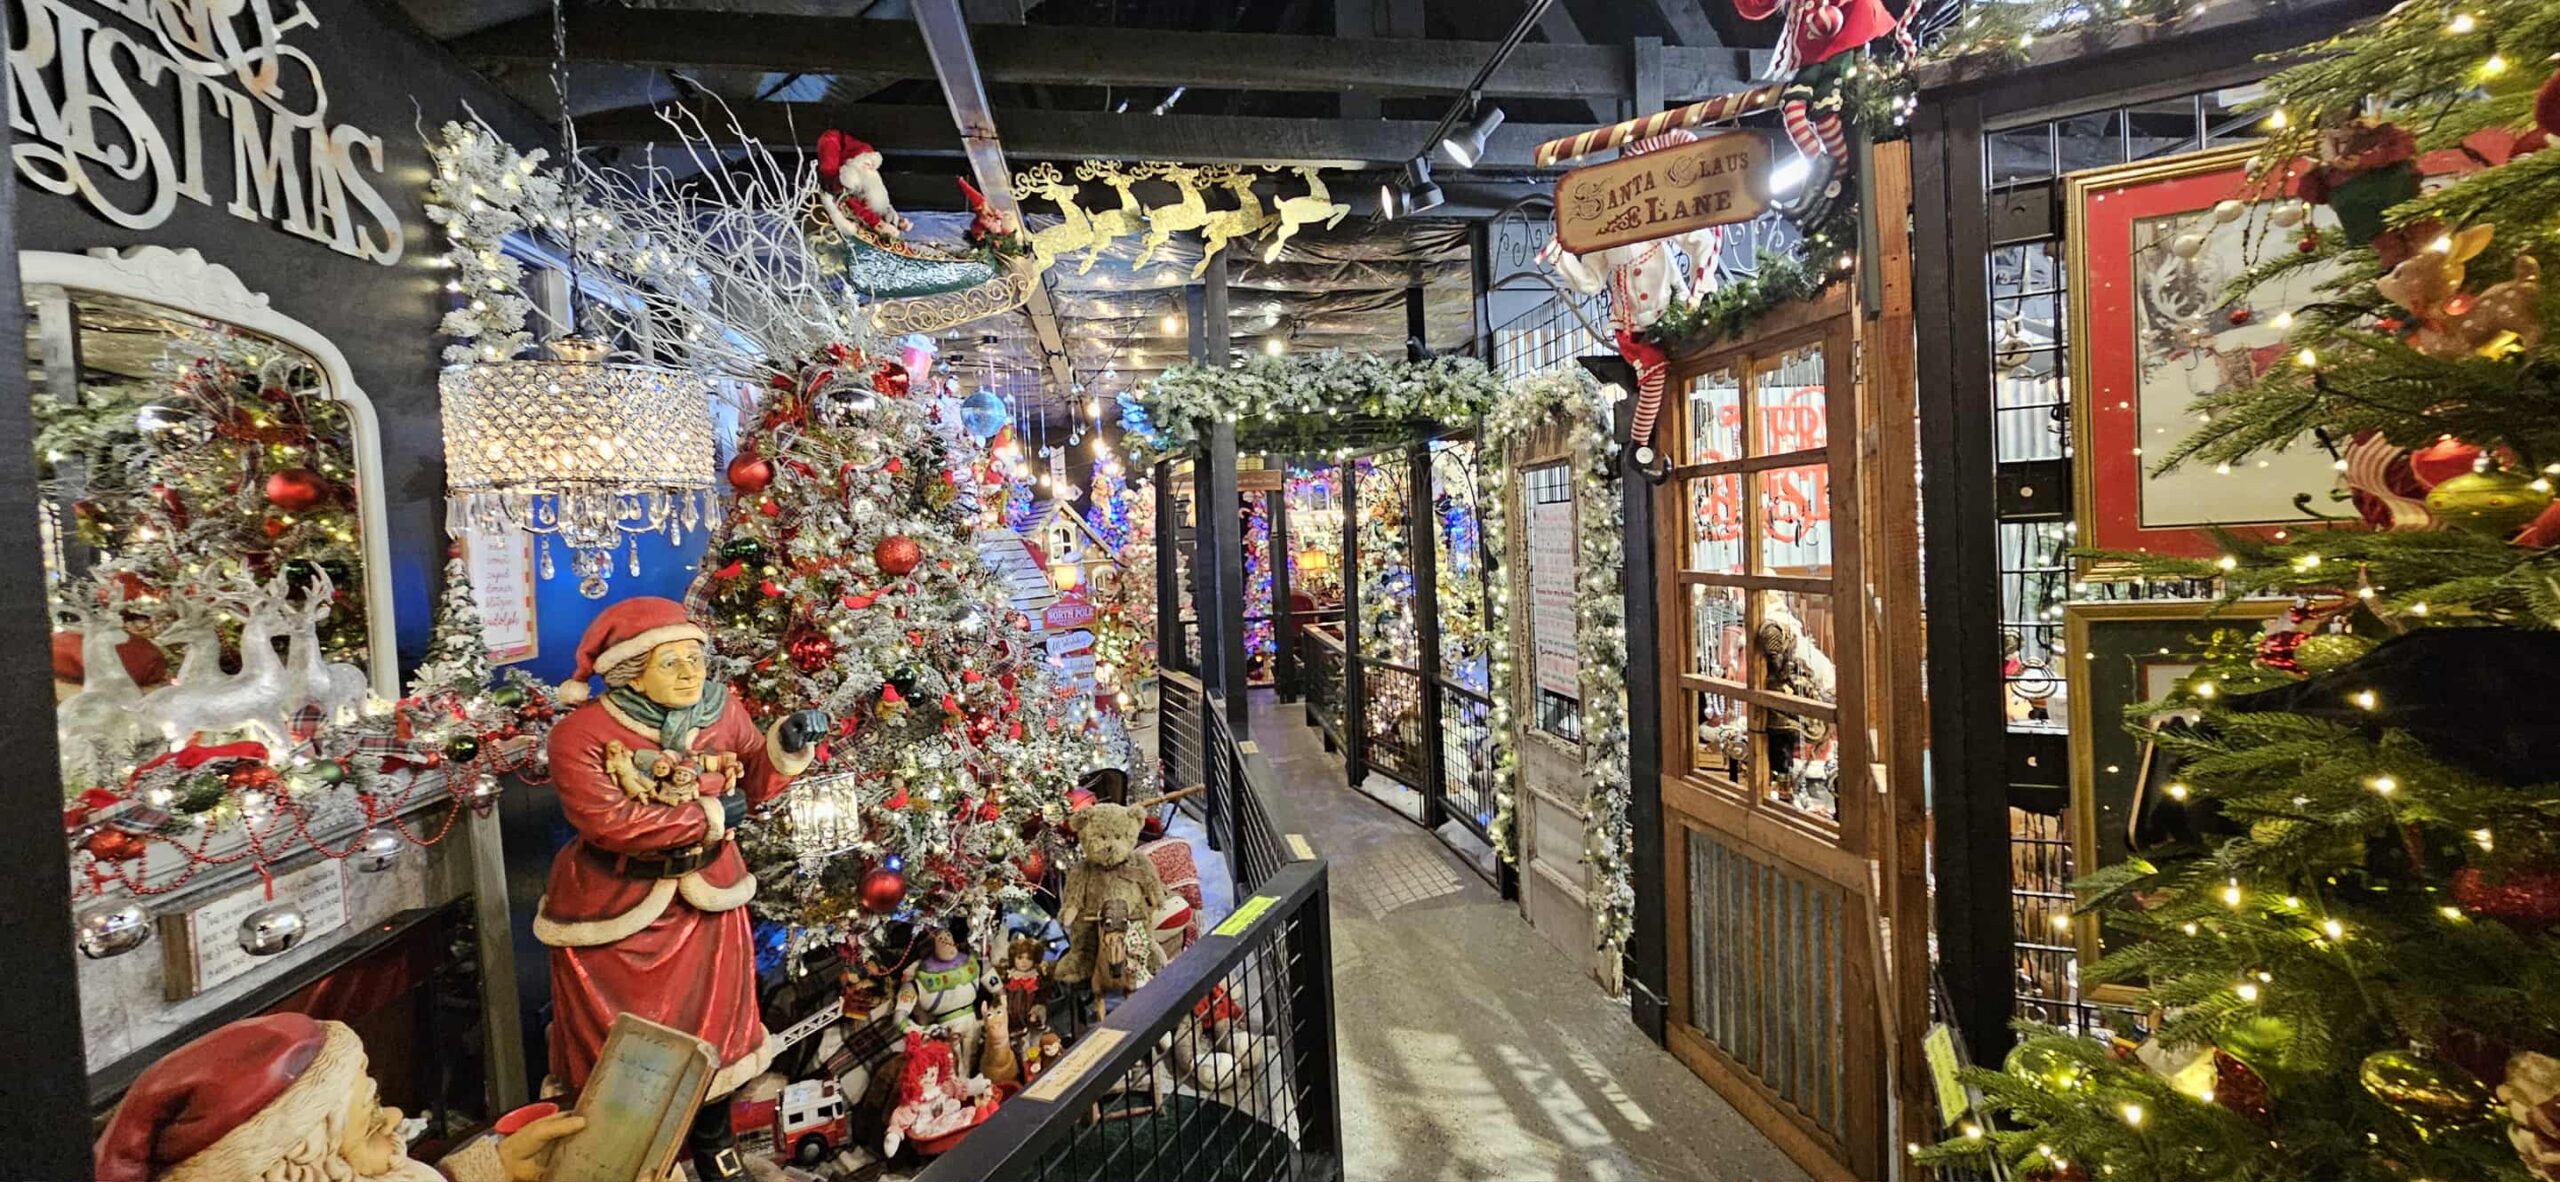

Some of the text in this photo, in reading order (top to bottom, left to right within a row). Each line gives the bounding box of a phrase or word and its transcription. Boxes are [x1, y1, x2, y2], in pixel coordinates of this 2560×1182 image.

[1568, 152, 1749, 224] SANTA CLAUS
[1645, 191, 1732, 224] LANE
